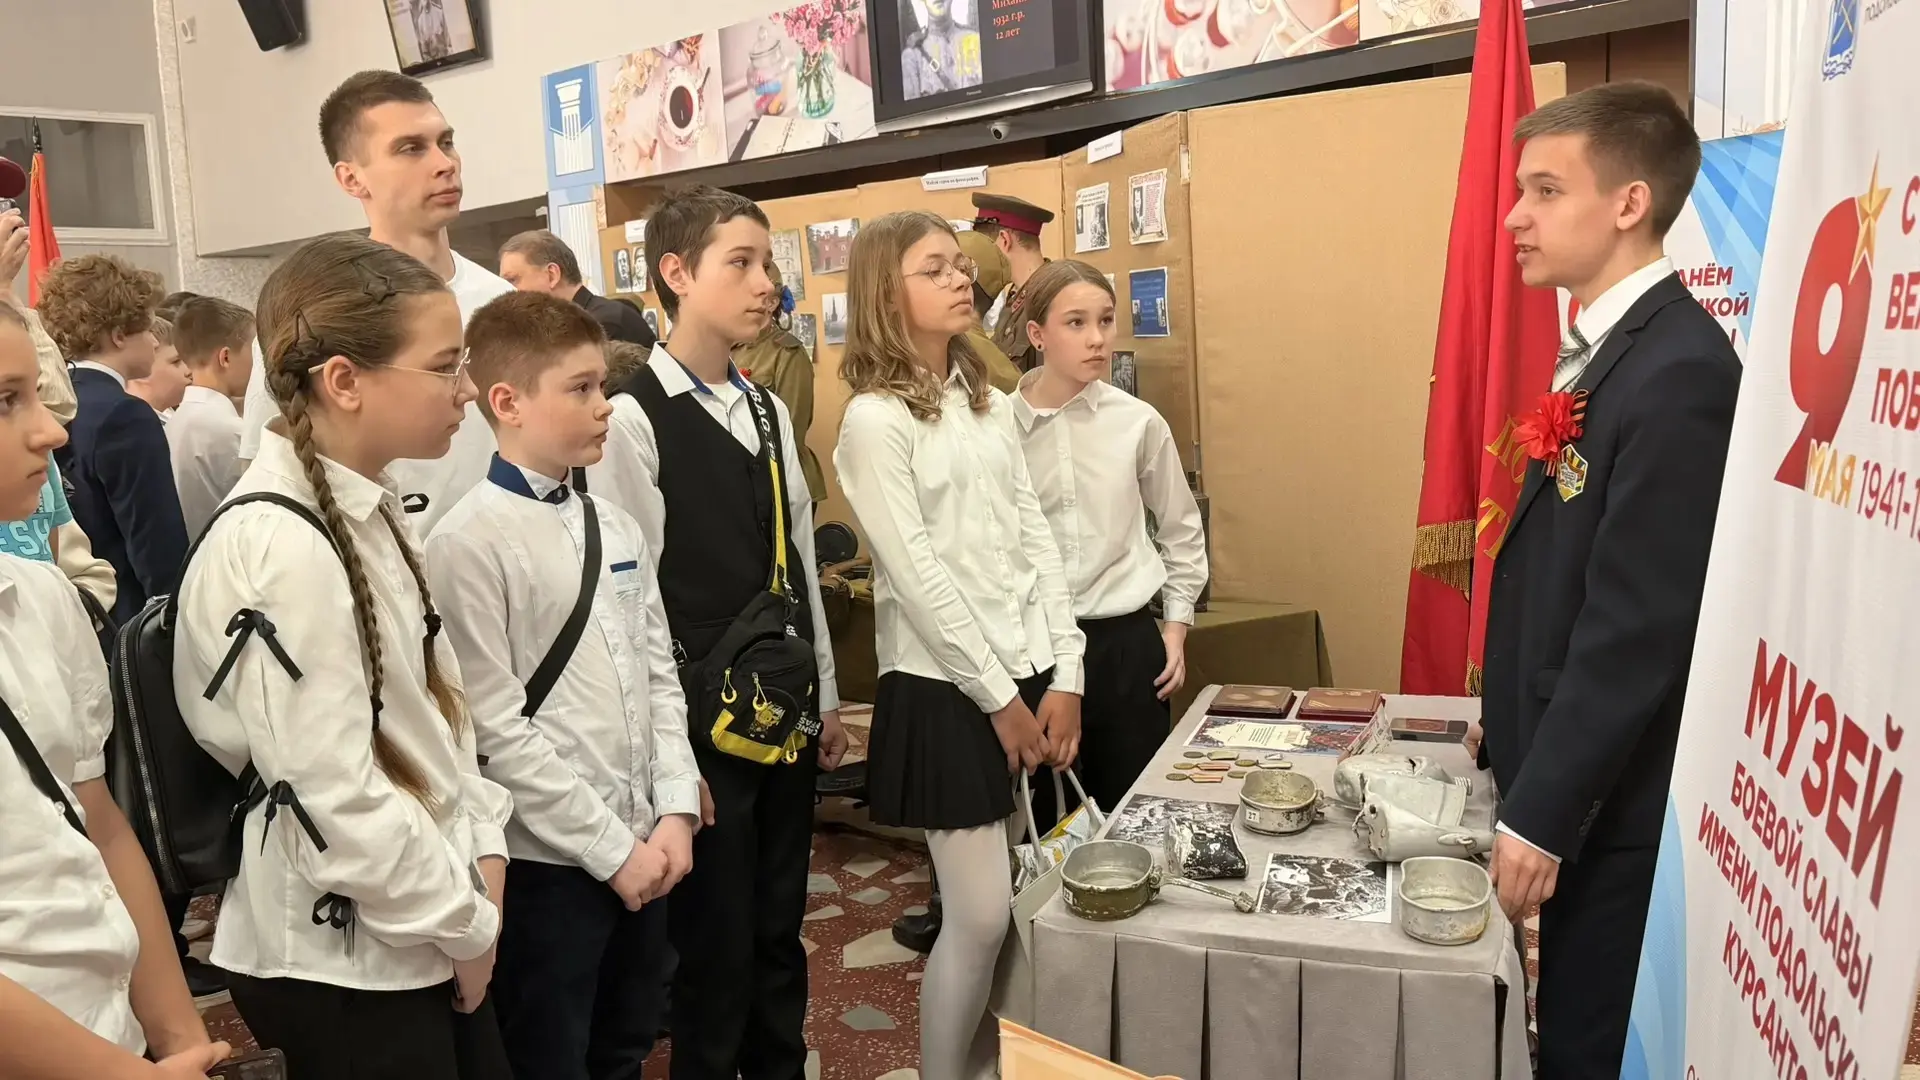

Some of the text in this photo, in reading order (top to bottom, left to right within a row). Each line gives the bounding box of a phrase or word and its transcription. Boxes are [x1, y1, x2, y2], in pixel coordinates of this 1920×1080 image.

[993, 14, 1010, 26] 1932
[996, 28, 1020, 40] 12 лет
[1699, 291, 1749, 317] КОЙ
[1885, 272, 1920, 330] ВЕ
[1806, 438, 1920, 543] МАЯ 1941-1
[1744, 636, 1905, 912] МУЗЕЙ
[1730, 759, 1873, 1015] БОЕВОЙ СЛАВЫ
[1698, 801, 1866, 1080] ИМЕНИ ПОДОЛЬСК
[1722, 919, 1808, 1080] КУРСАНТ
